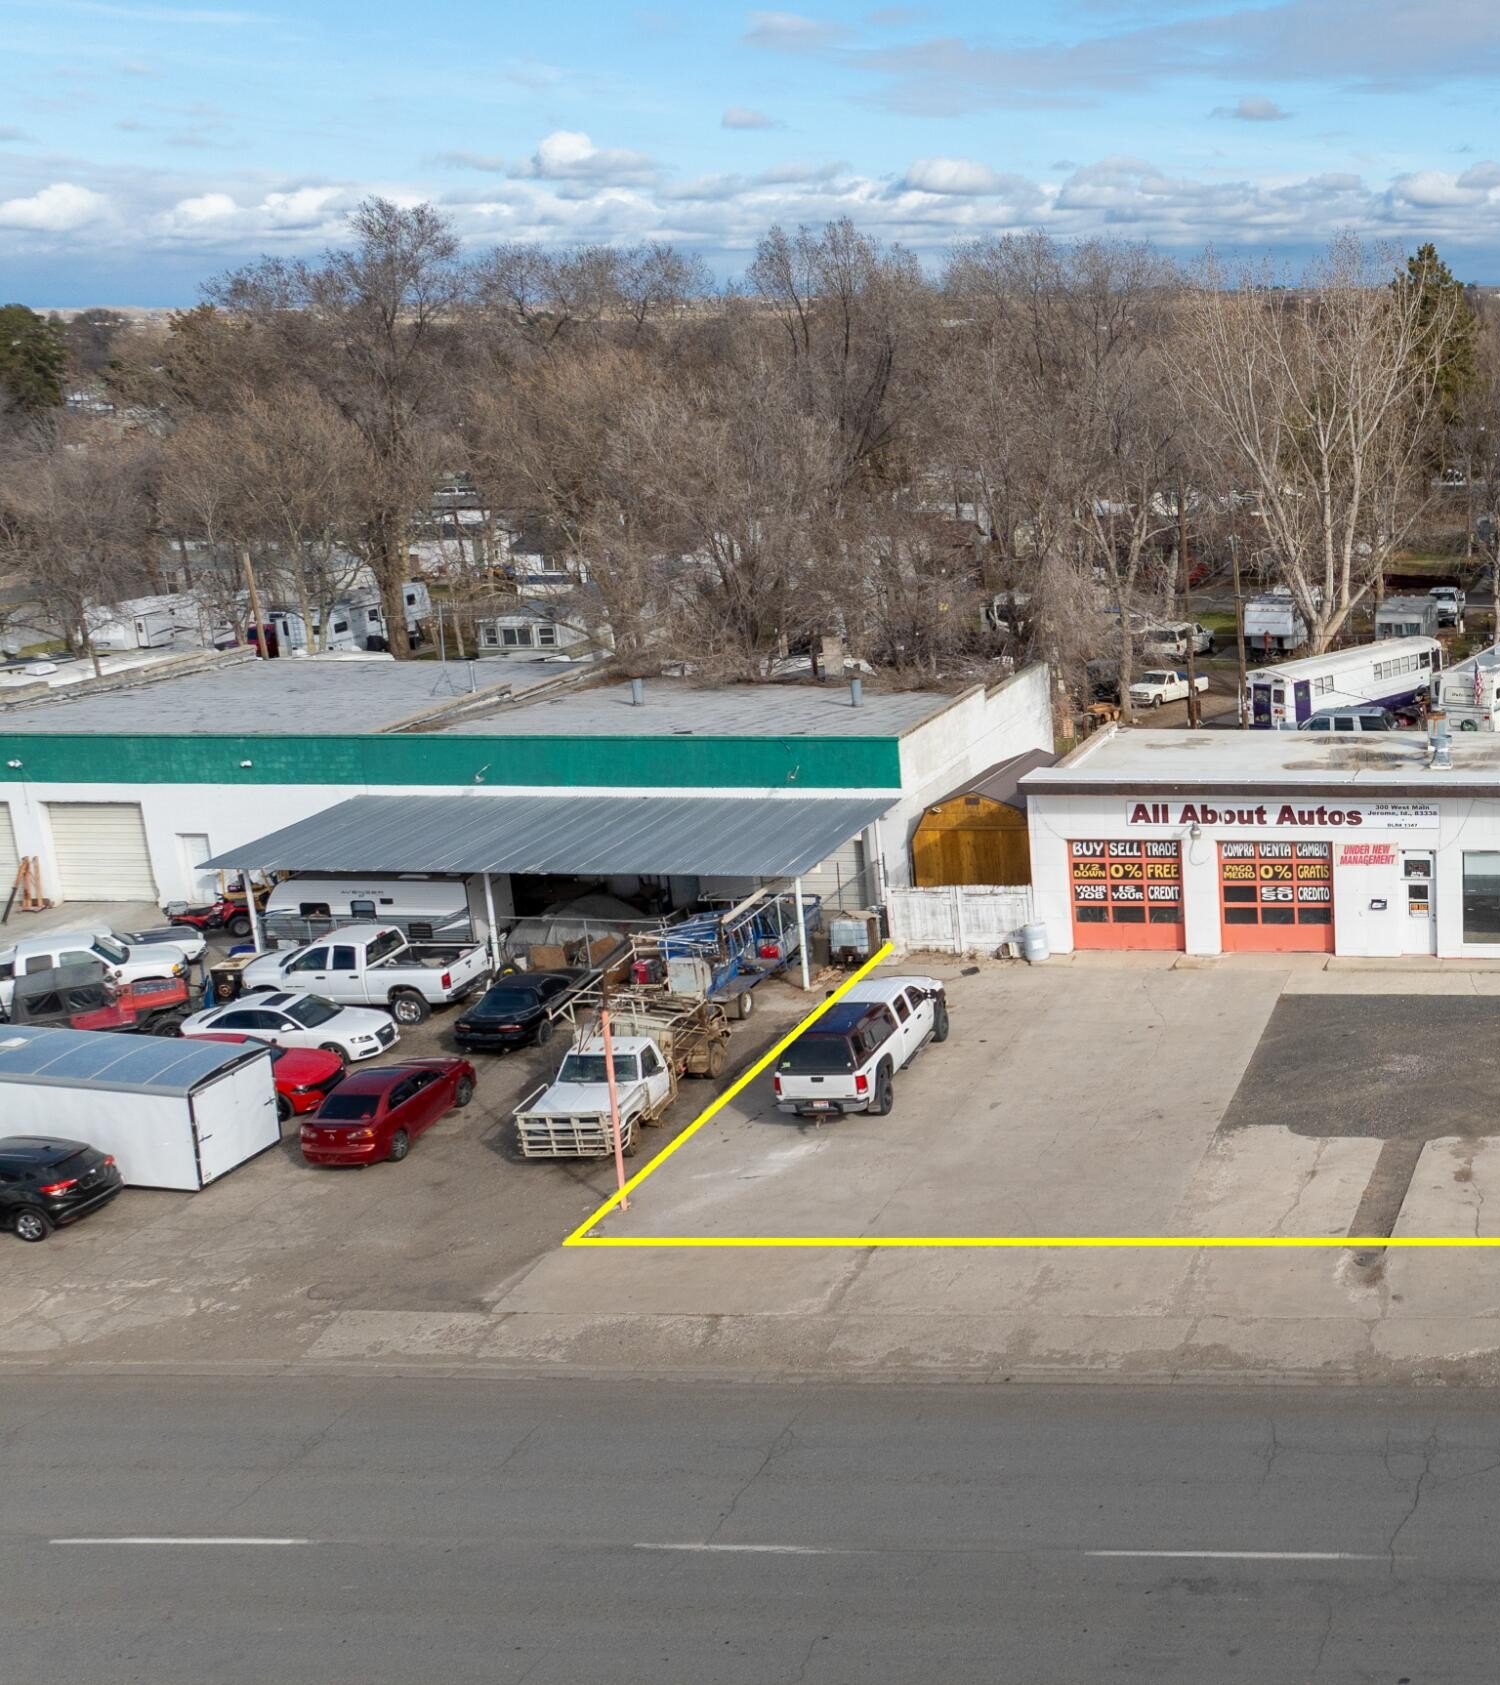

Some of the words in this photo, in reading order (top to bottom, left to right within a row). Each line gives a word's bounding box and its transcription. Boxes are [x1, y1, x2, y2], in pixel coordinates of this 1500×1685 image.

[1131, 803, 1169, 824] All
[1179, 803, 1267, 825] About
[1275, 804, 1363, 825] Autos
[1072, 841, 1104, 856] BUY
[1109, 842, 1142, 856] SELL
[1145, 842, 1178, 857] TRADE
[1222, 842, 1255, 857] COMPRA
[1259, 843, 1292, 857] VENTA
[1296, 842, 1329, 857] CAMBIO
[1343, 844, 1370, 854] UNDER
[1372, 844, 1391, 854] NEW
[1339, 854, 1396, 865] MANAGEMENT
[1073, 870, 1106, 878] DOWN
[1079, 863, 1100, 871] 1/2
[1110, 864, 1142, 878] 0%
[1147, 864, 1179, 878] FREE
[1225, 864, 1253, 872] PAGO
[1260, 865, 1292, 879] 0%
[1297, 865, 1330, 879] GRATIS
[1223, 871, 1256, 879] MEDIO
[1148, 885, 1180, 900] CREDIT
[1297, 887, 1330, 900] CREDITO
